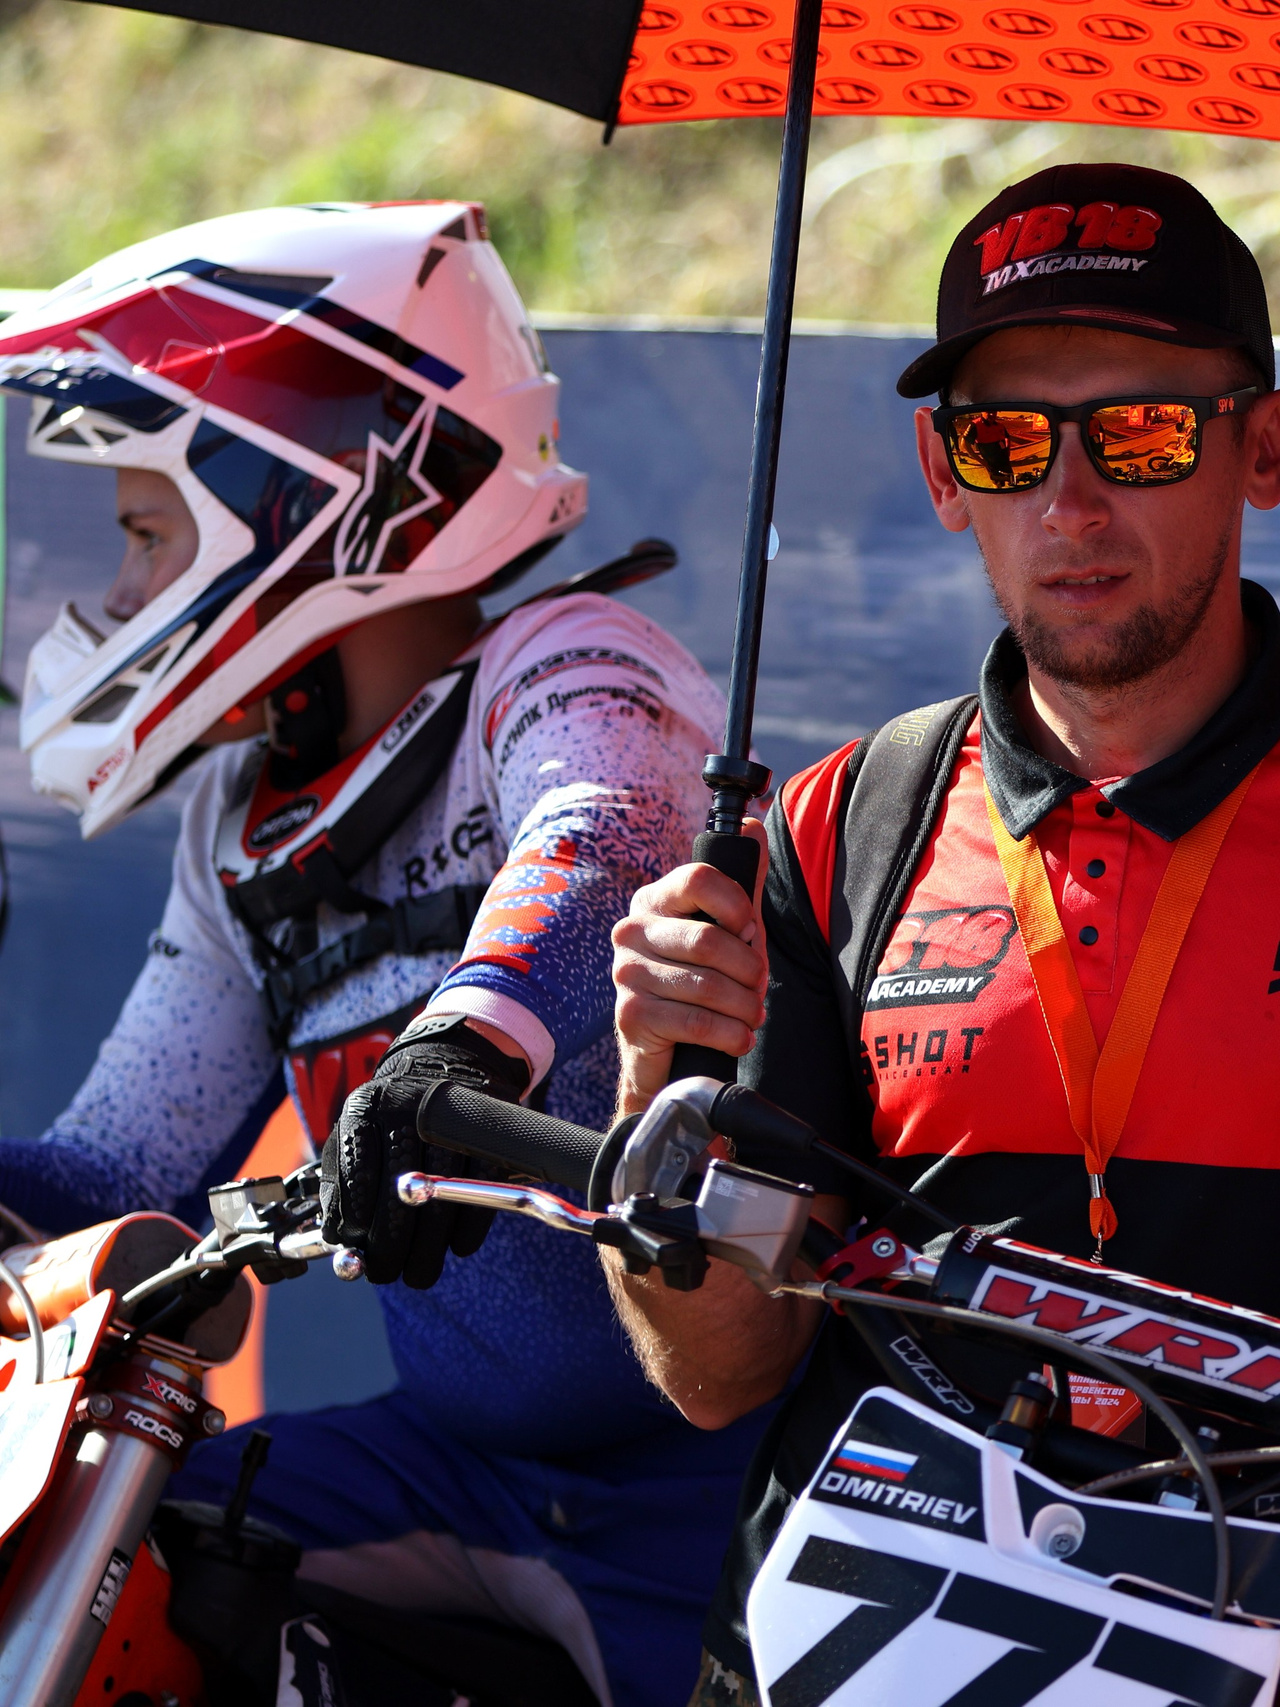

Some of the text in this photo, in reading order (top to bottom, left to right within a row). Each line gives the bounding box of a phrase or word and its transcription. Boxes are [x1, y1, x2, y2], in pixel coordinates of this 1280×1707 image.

[974, 201, 1163, 276] VB18
[981, 254, 1149, 297] MXACADEMY
[874, 1026, 985, 1070] SHOT
[140, 1372, 197, 1413] XTRIG
[889, 1335, 975, 1413] WRP
[1070, 1385, 1126, 1396] ЕРВЕНСТВО
[1095, 1397, 1120, 1407] 2024
[124, 1409, 184, 1449] ROCS
[819, 1471, 978, 1525] DMITRIEV
